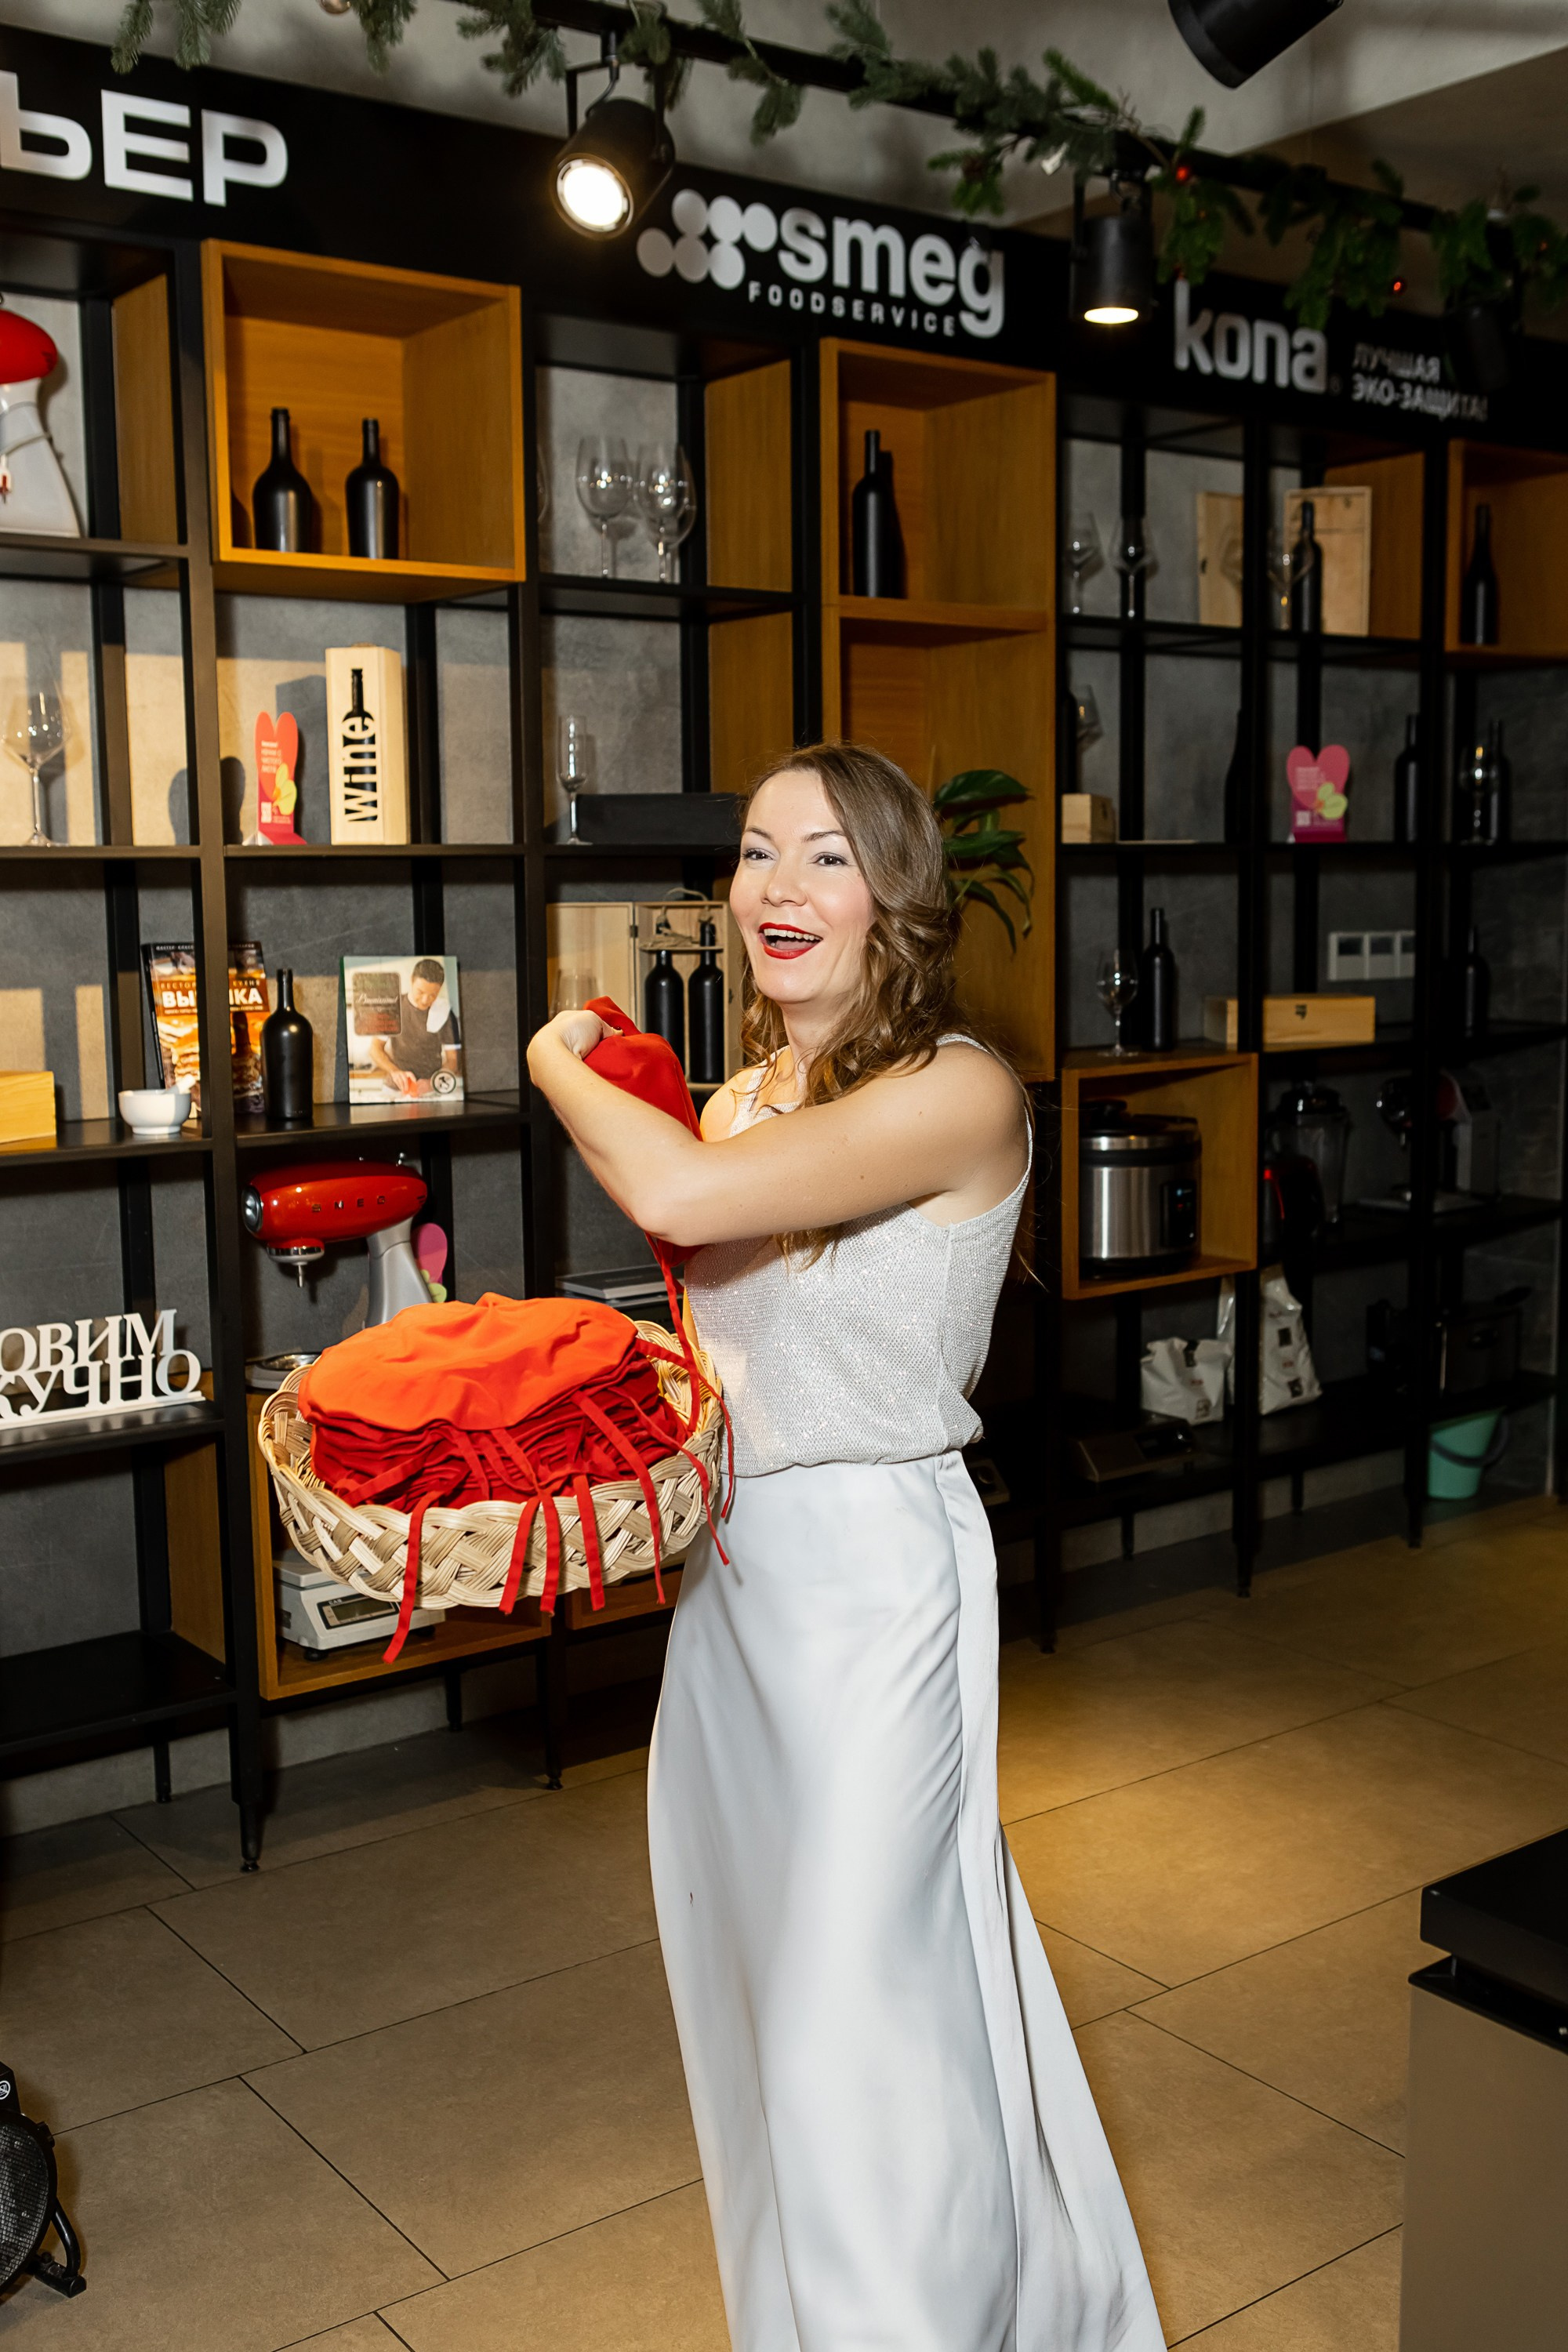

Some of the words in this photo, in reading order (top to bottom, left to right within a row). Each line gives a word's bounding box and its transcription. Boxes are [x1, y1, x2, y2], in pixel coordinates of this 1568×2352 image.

[749, 281, 956, 337] FOODSERVICE
[778, 207, 1005, 339] smeg
[1174, 278, 1327, 393] kona
[1352, 342, 1441, 384] ЛУЧШАЯ
[342, 716, 378, 822] wine
[312, 1196, 386, 1213] SMEG
